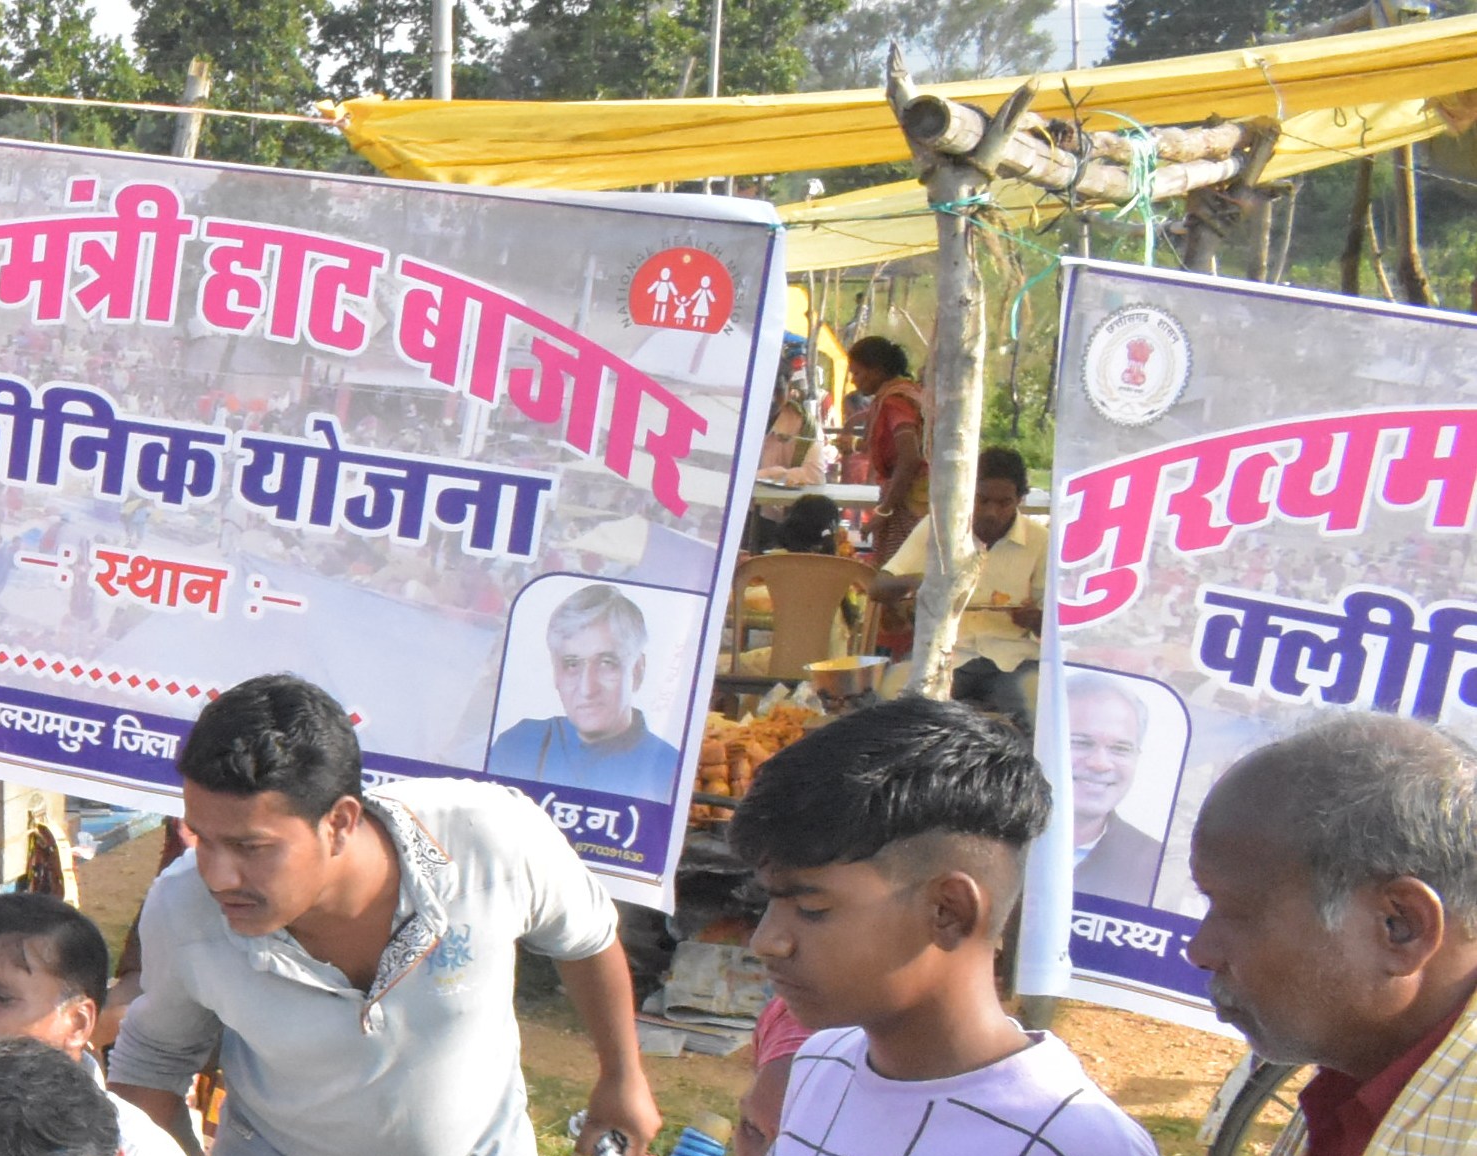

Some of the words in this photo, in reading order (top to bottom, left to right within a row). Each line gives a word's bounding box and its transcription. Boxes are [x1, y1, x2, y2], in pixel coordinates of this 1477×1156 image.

[616, 246, 656, 329] NATIONAL
[661, 235, 724, 258] HEALTH
[721, 259, 745, 336] MISSION
[202, 220, 385, 352] हाट
[399, 258, 709, 519] बाजार
[240, 419, 552, 556] योजना
[1058, 406, 1477, 626] मुख्यम
[94, 549, 229, 614] स्थान
[112, 713, 182, 761] जिला
